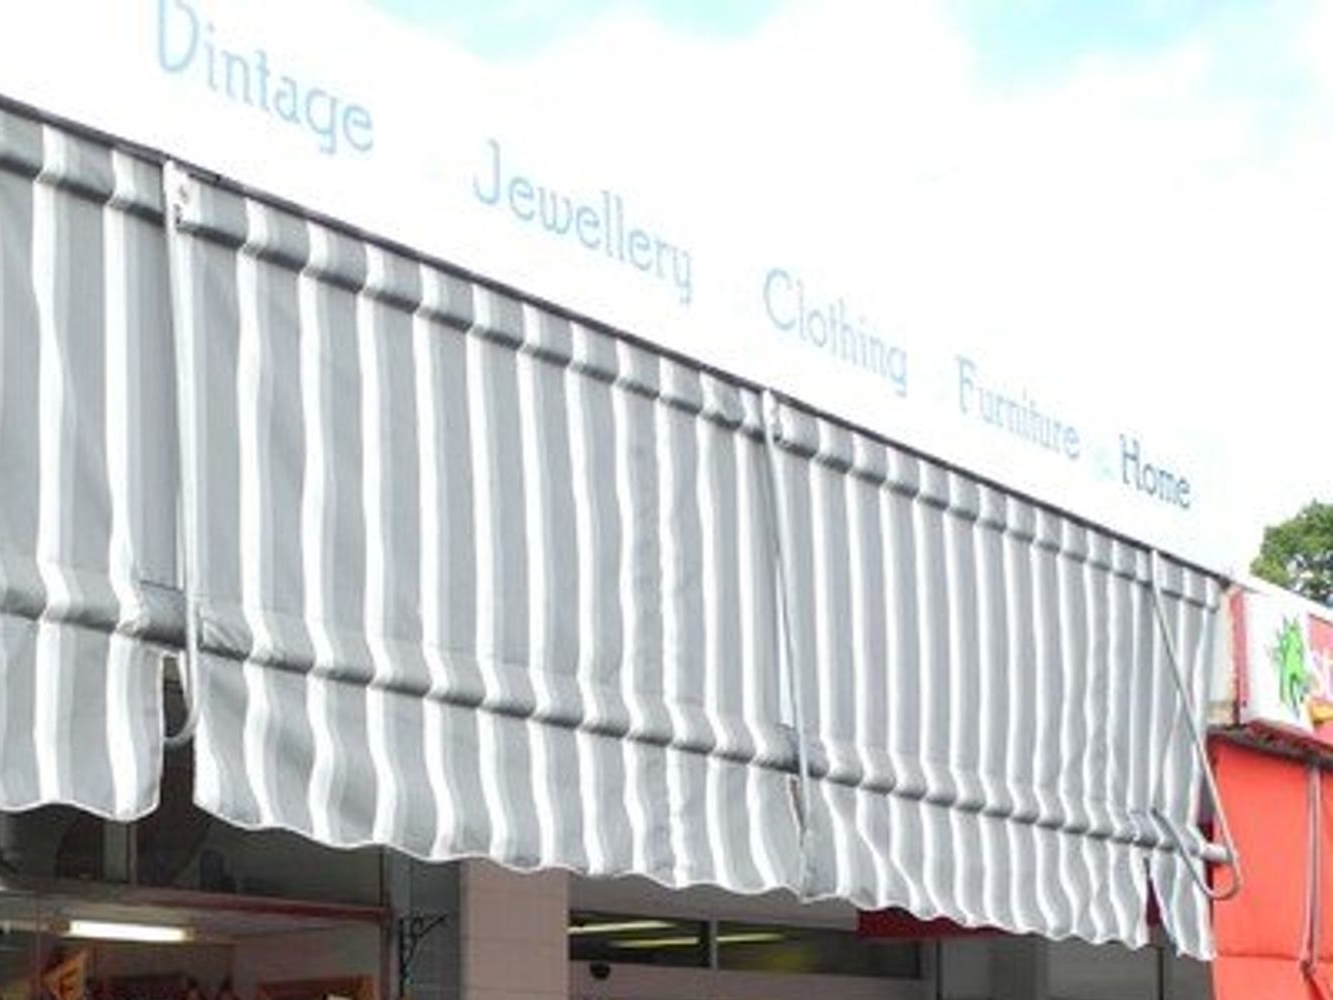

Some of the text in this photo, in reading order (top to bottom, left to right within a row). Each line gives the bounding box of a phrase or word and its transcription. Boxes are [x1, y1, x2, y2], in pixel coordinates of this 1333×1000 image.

[472, 138, 693, 305] Jewellery
[763, 267, 907, 398] Clothing
[954, 353, 1081, 461] Furniture
[1119, 432, 1192, 511] Home
